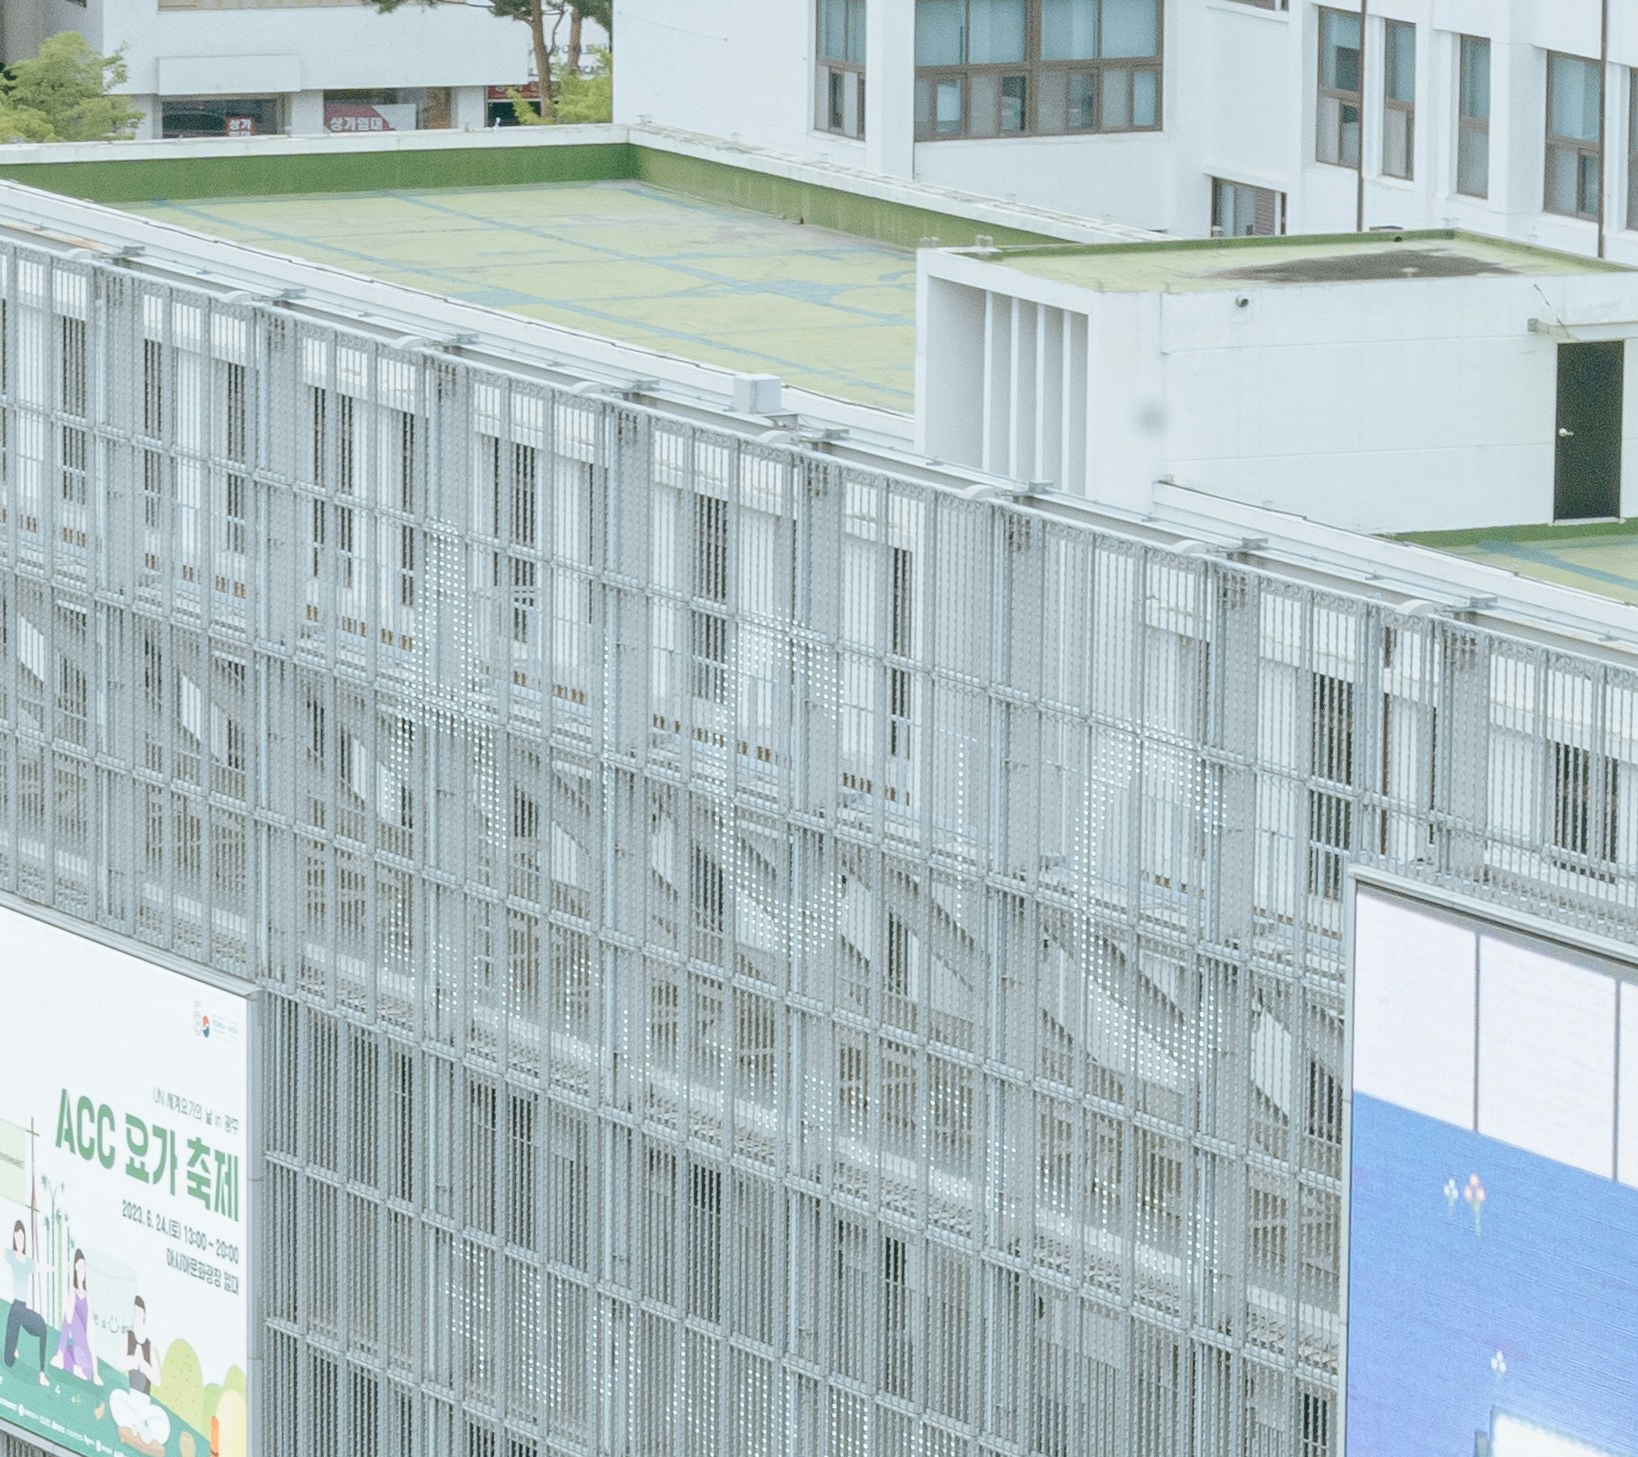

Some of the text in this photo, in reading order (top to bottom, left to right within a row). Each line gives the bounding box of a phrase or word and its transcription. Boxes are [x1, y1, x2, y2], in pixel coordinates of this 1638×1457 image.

[228, 118, 252, 130] 상가
[330, 116, 383, 131] 상가임대
[168, 1091, 202, 1122] 세계요가의
[225, 1114, 239, 1136] 광주
[55, 1088, 239, 1222] ACC 요가 축제
[122, 1199, 146, 1226] 2023.
[184, 1224, 207, 1250] 13:00
[216, 1237, 239, 1265] 20:00
[167, 1247, 239, 1294] 아시아문화광장 일대
